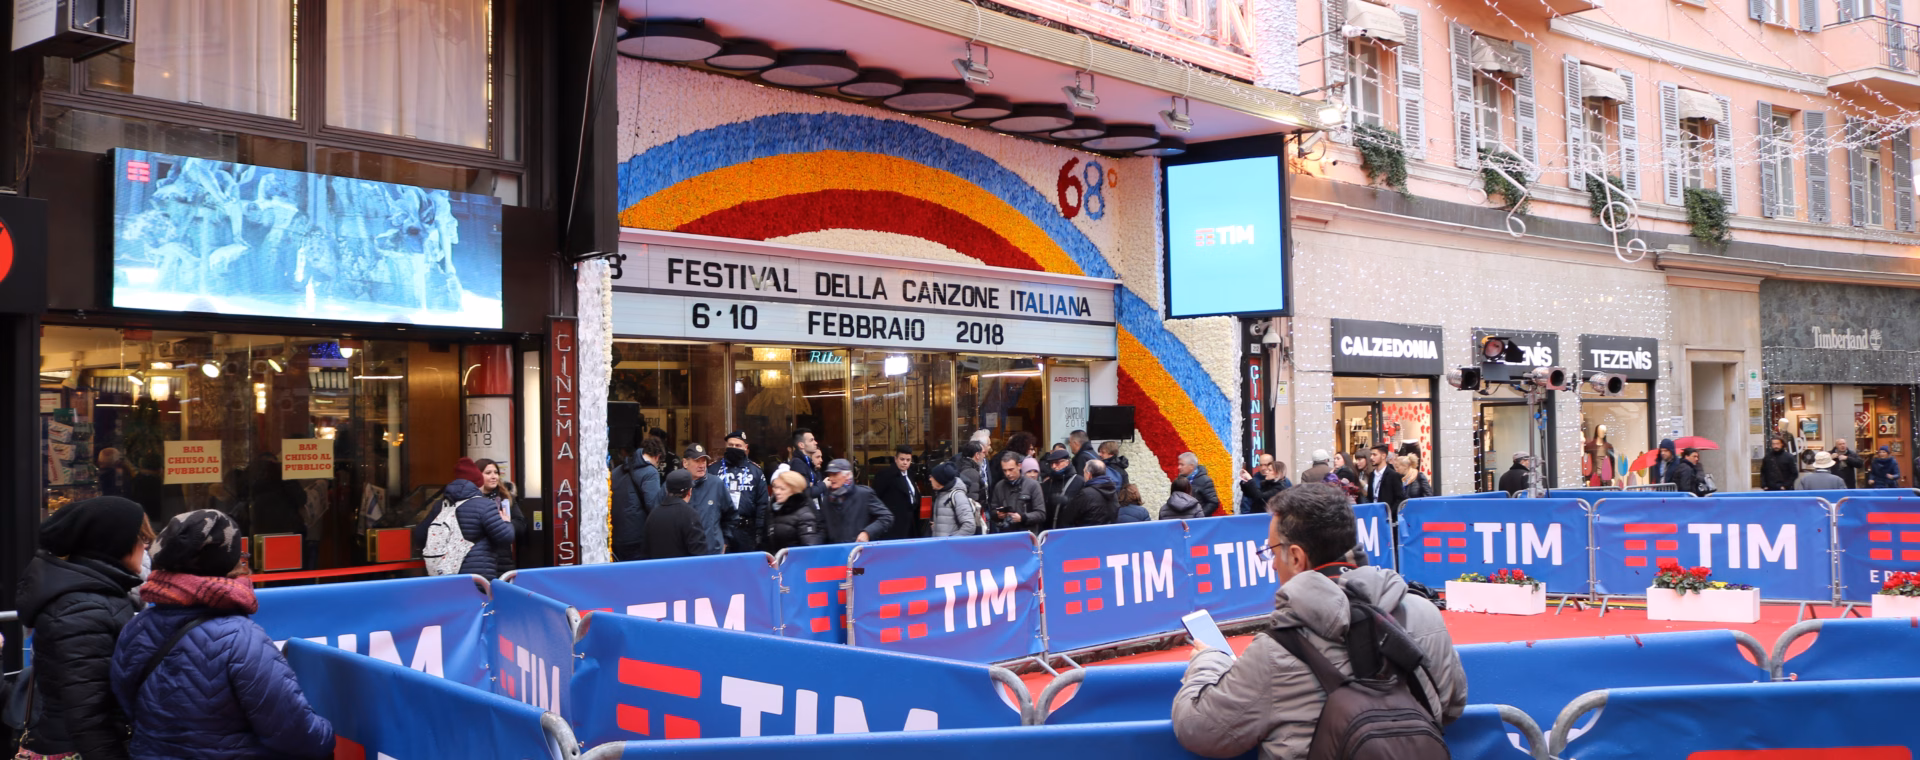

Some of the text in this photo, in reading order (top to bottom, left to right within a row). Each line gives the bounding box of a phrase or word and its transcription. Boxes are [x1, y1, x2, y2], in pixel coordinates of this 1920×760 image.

[1216, 225, 1255, 246] TIM
[667, 257, 798, 294] FESTIVAL
[815, 271, 888, 301] DELLA
[902, 278, 1000, 310] CANZONE
[1010, 289, 1092, 317] ITALIANA
[808, 310, 926, 342] FEBBRAIO
[956, 321, 1005, 346] 2018
[1811, 325, 1869, 350] Timberland
[1340, 335, 1439, 360] CALZEDONIA
[1250, 364, 1262, 469] CINEMA
[168, 456, 205, 464] CHIUSO
[285, 453, 332, 461] CHIUSO AL
[298, 443, 318, 451] BAR
[555, 333, 575, 566] CINEMA ARIS
[167, 466, 219, 475] PUBBLICO
[284, 463, 332, 471] PUBBLICO
[1474, 522, 1562, 566] TIM
[1687, 523, 1798, 570] TIM
[1106, 548, 1175, 607] TIM
[934, 565, 1017, 632] TIM
[516, 645, 561, 717] TIM
